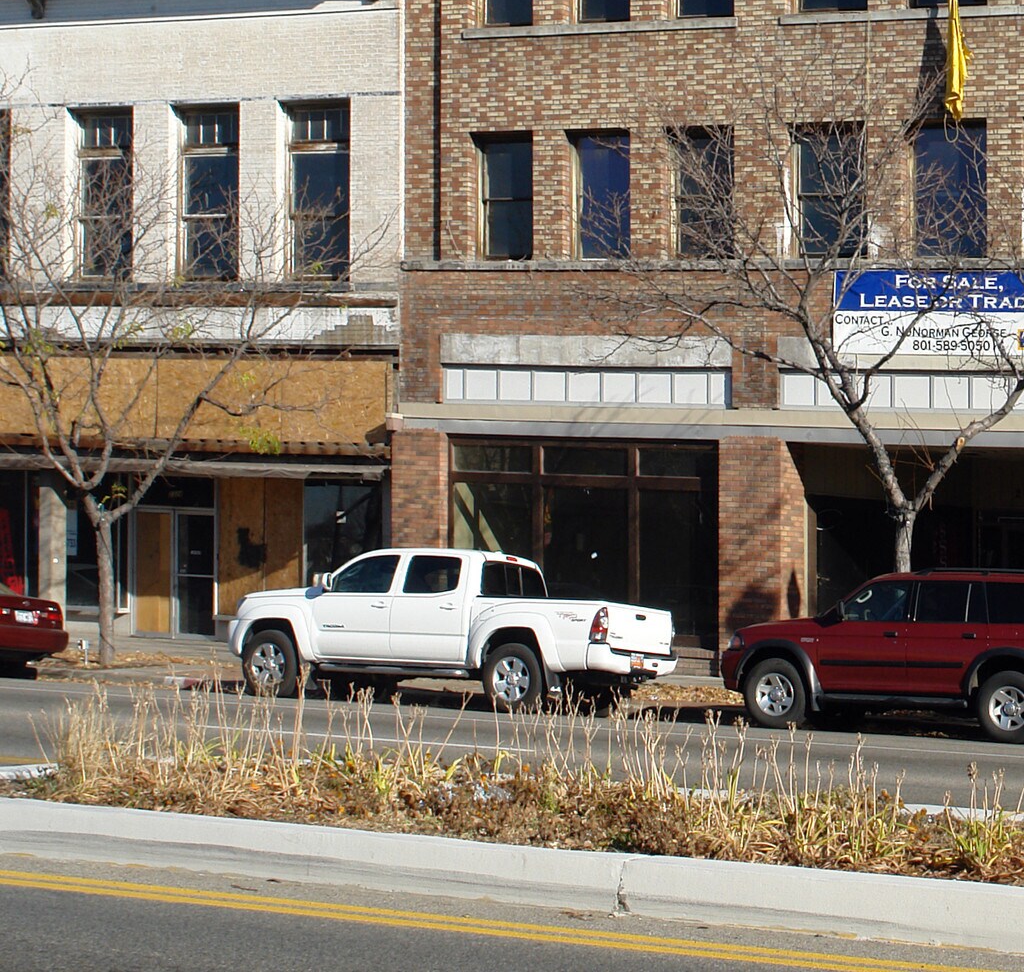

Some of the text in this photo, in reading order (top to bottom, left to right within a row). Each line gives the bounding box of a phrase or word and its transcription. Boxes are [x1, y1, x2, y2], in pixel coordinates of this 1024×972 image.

[895, 274, 1004, 292] FOR SALE,
[860, 293, 929, 308] LEASE
[932, 295, 963, 308] OR
[912, 339, 991, 351] 801-589-5050
